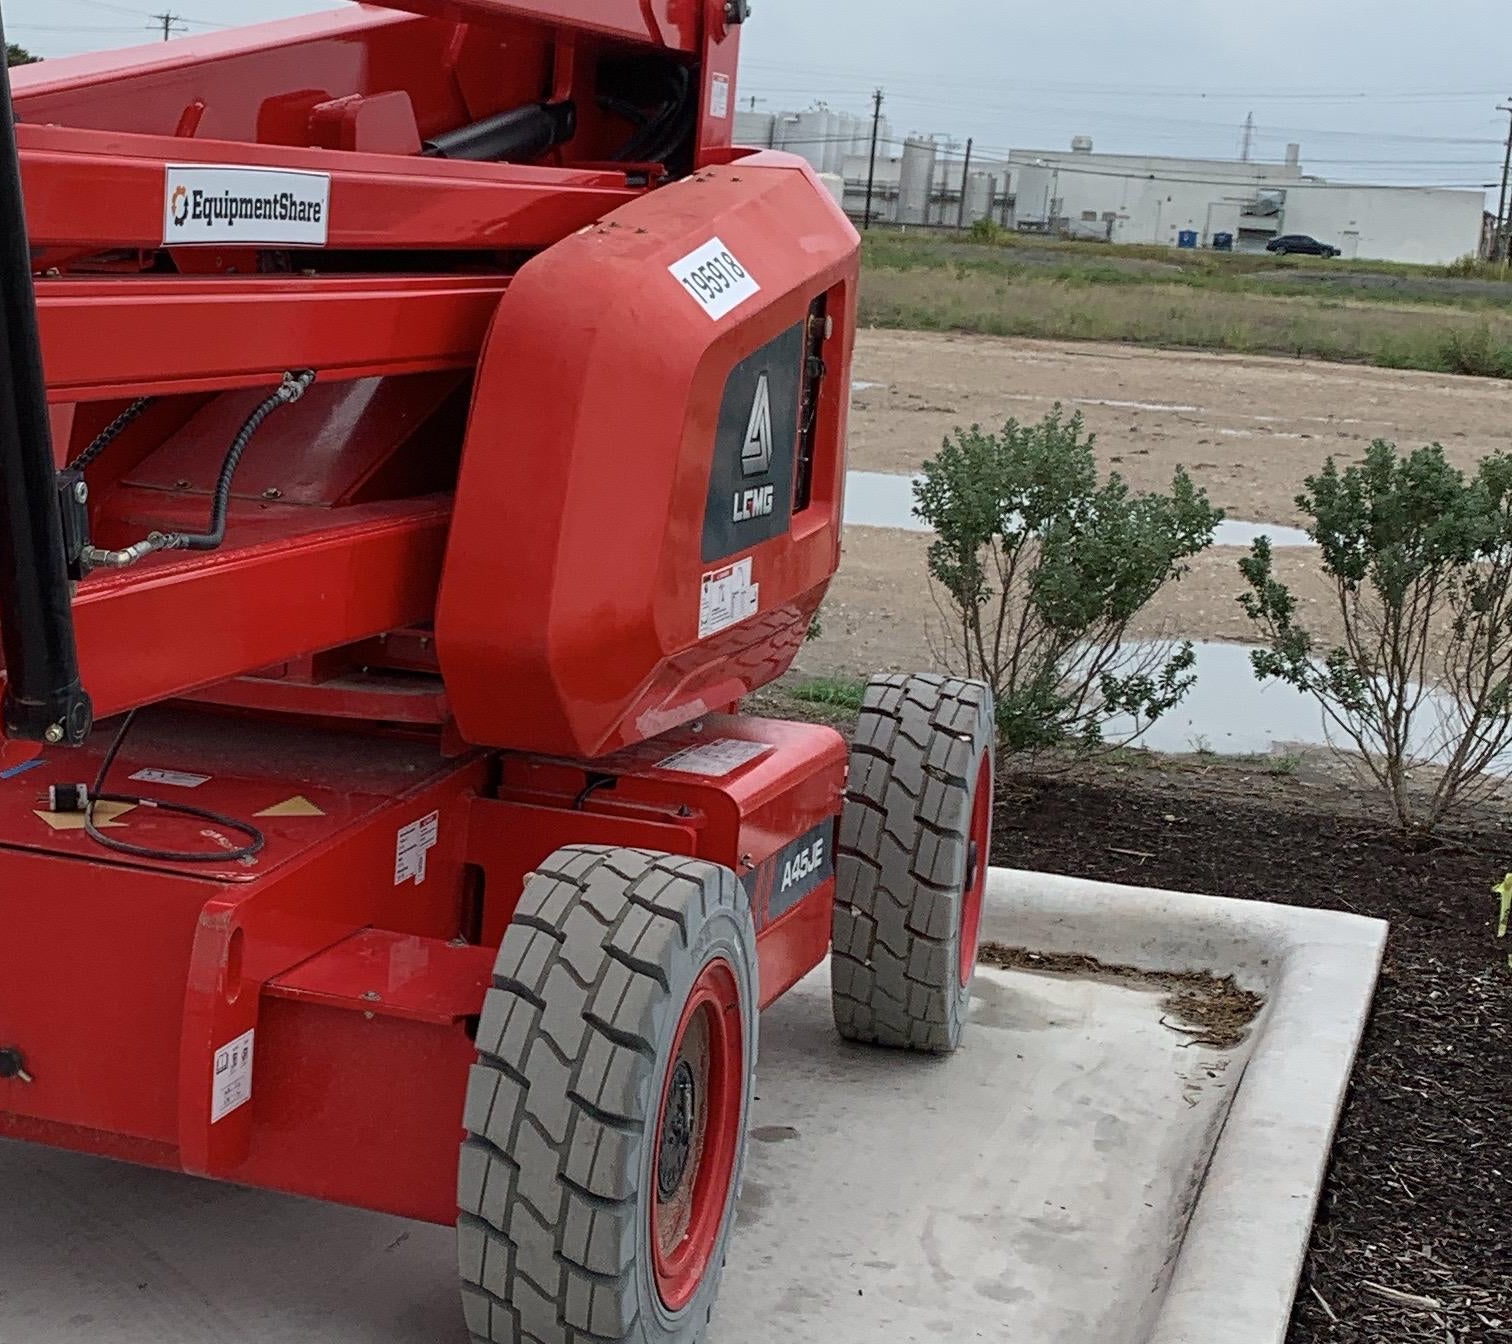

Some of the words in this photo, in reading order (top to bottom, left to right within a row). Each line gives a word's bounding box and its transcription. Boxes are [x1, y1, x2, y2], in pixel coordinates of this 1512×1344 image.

[191, 190, 321, 226] EquipmentShare
[682, 251, 745, 304] 195918
[732, 483, 774, 523] LCMG
[781, 837, 824, 892] A45JE
